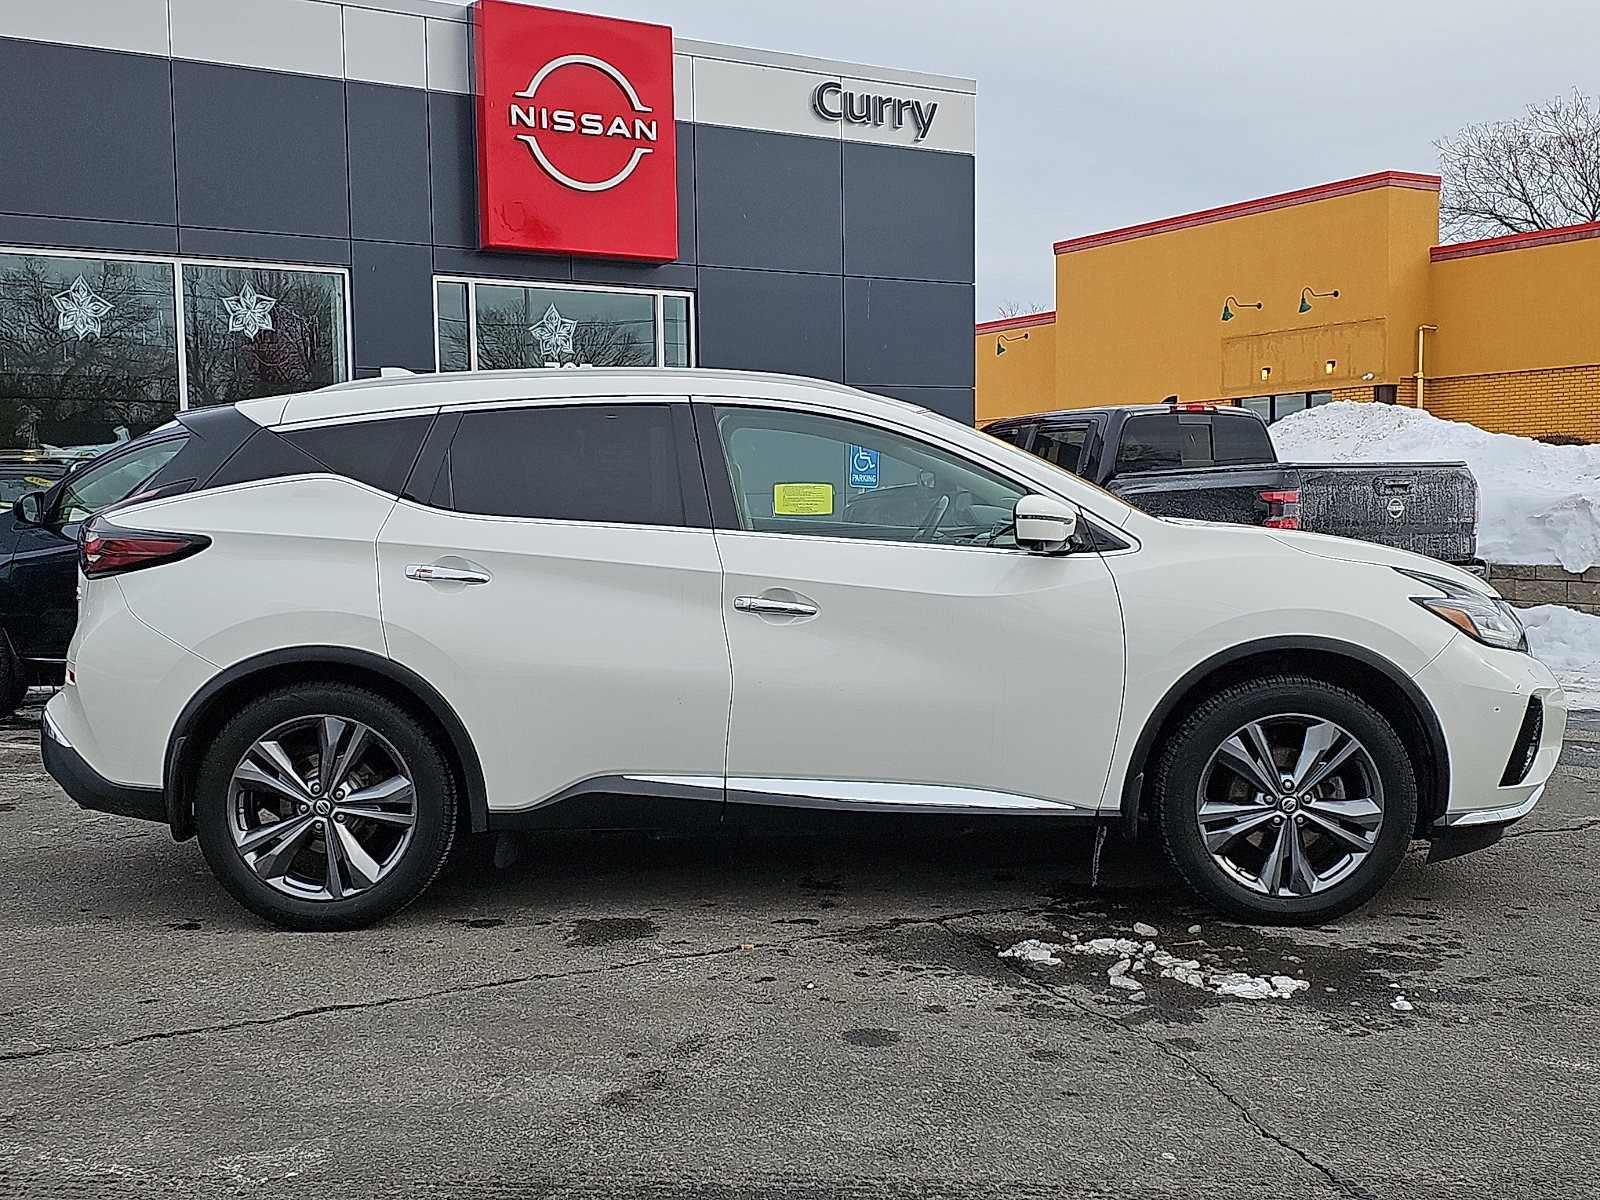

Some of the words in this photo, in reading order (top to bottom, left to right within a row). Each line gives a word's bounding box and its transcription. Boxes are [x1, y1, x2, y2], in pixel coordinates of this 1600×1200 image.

[509, 103, 657, 142] NISSAN
[813, 81, 938, 141] Curry
[851, 474, 877, 483] PARKING
